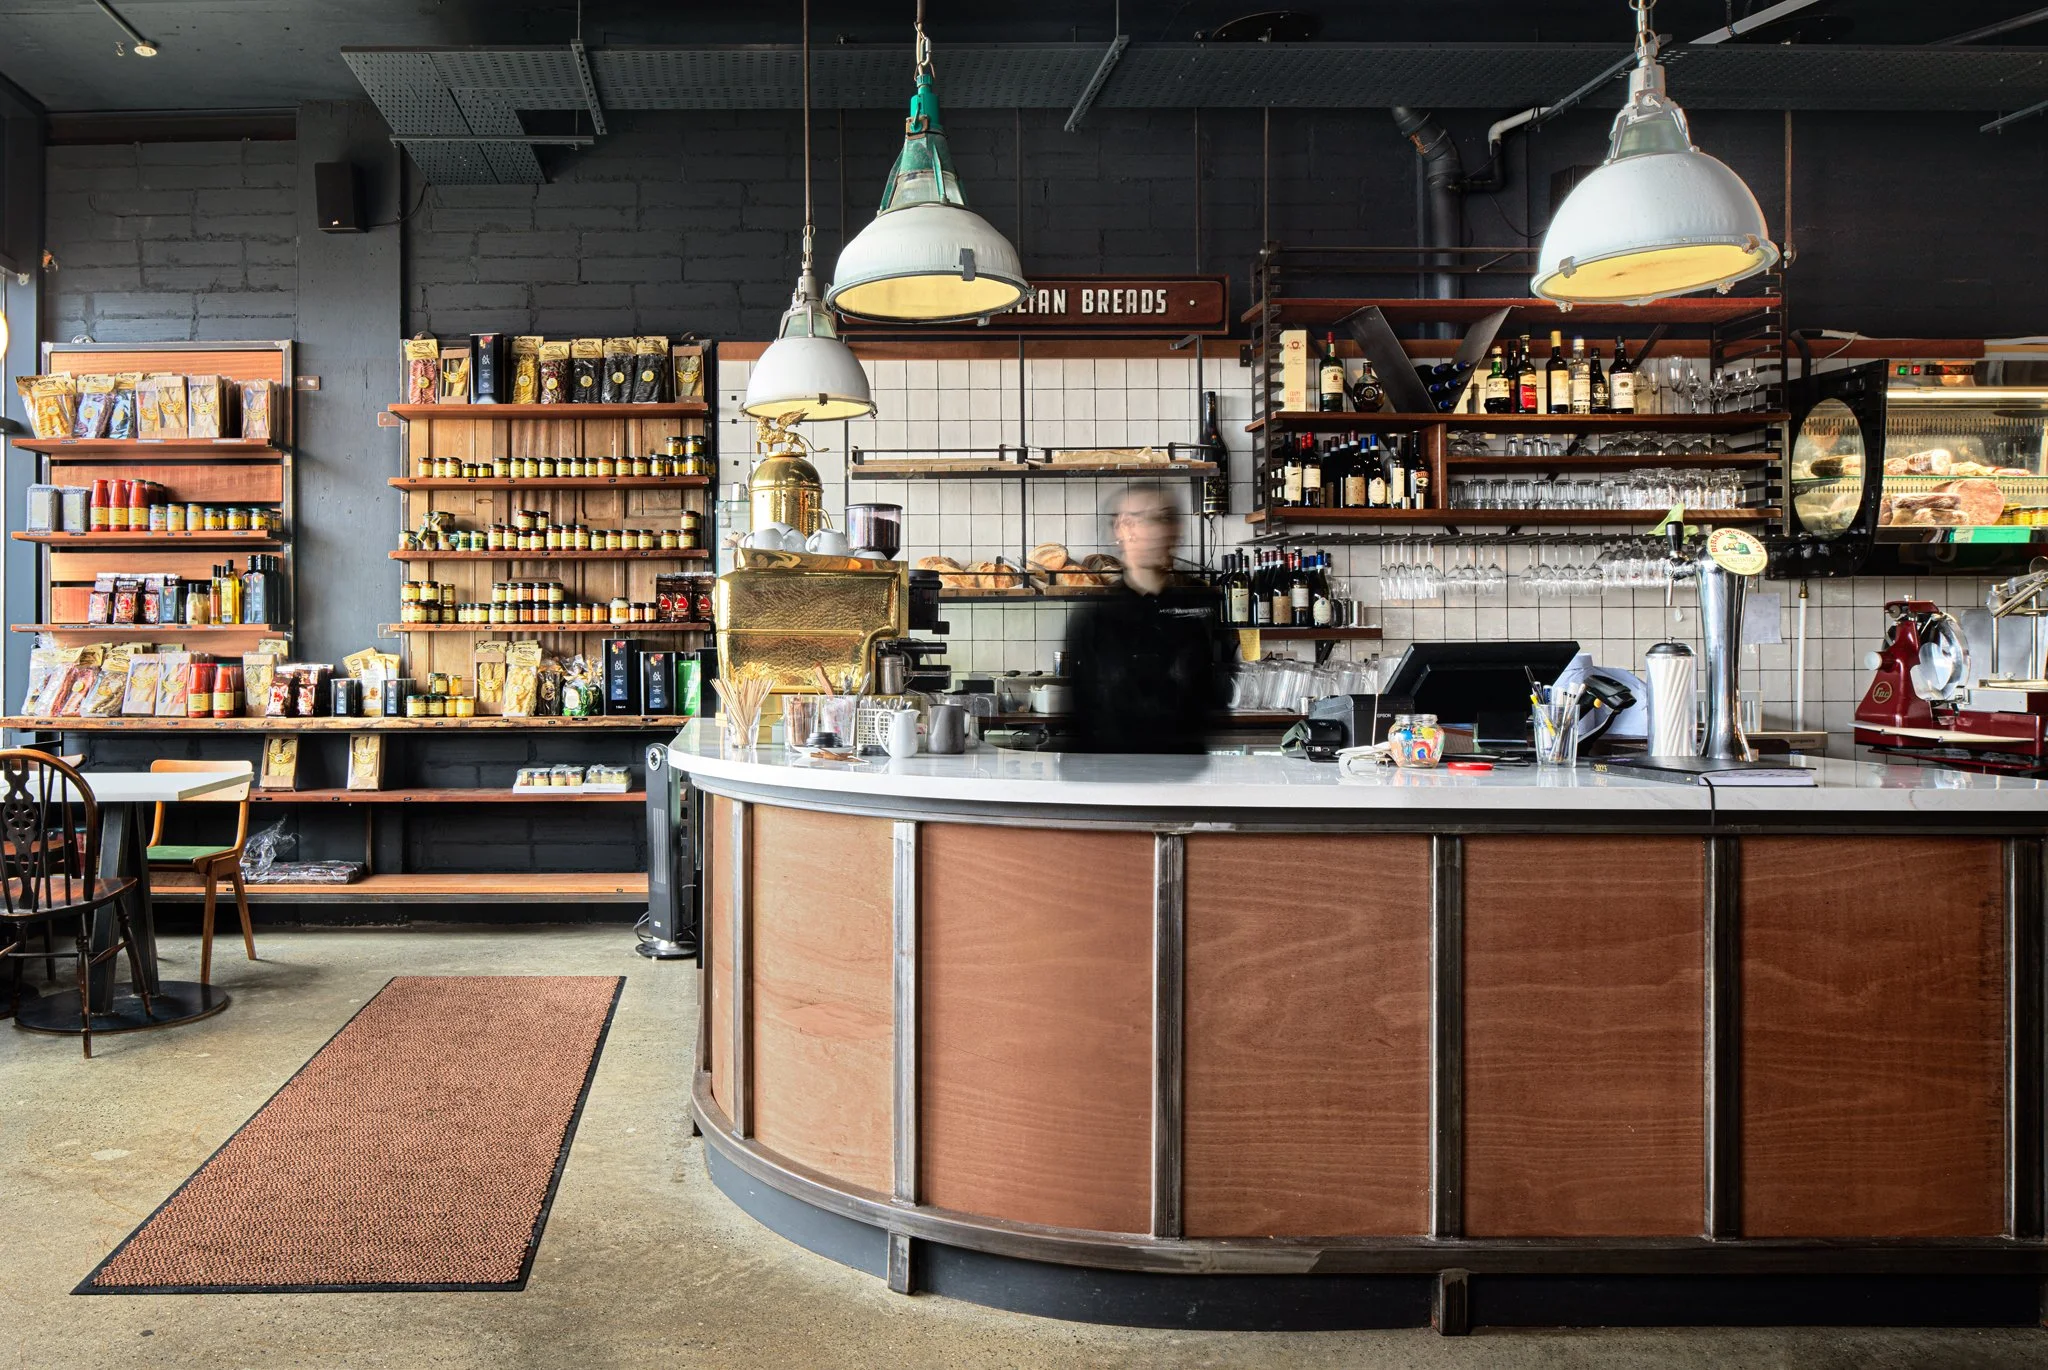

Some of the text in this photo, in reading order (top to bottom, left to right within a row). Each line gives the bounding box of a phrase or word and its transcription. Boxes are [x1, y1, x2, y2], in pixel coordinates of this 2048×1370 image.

[1003, 289, 1167, 314] LIAN BREADS
[1710, 531, 1725, 553] BIRRA
[1593, 764, 1608, 772] 2023
